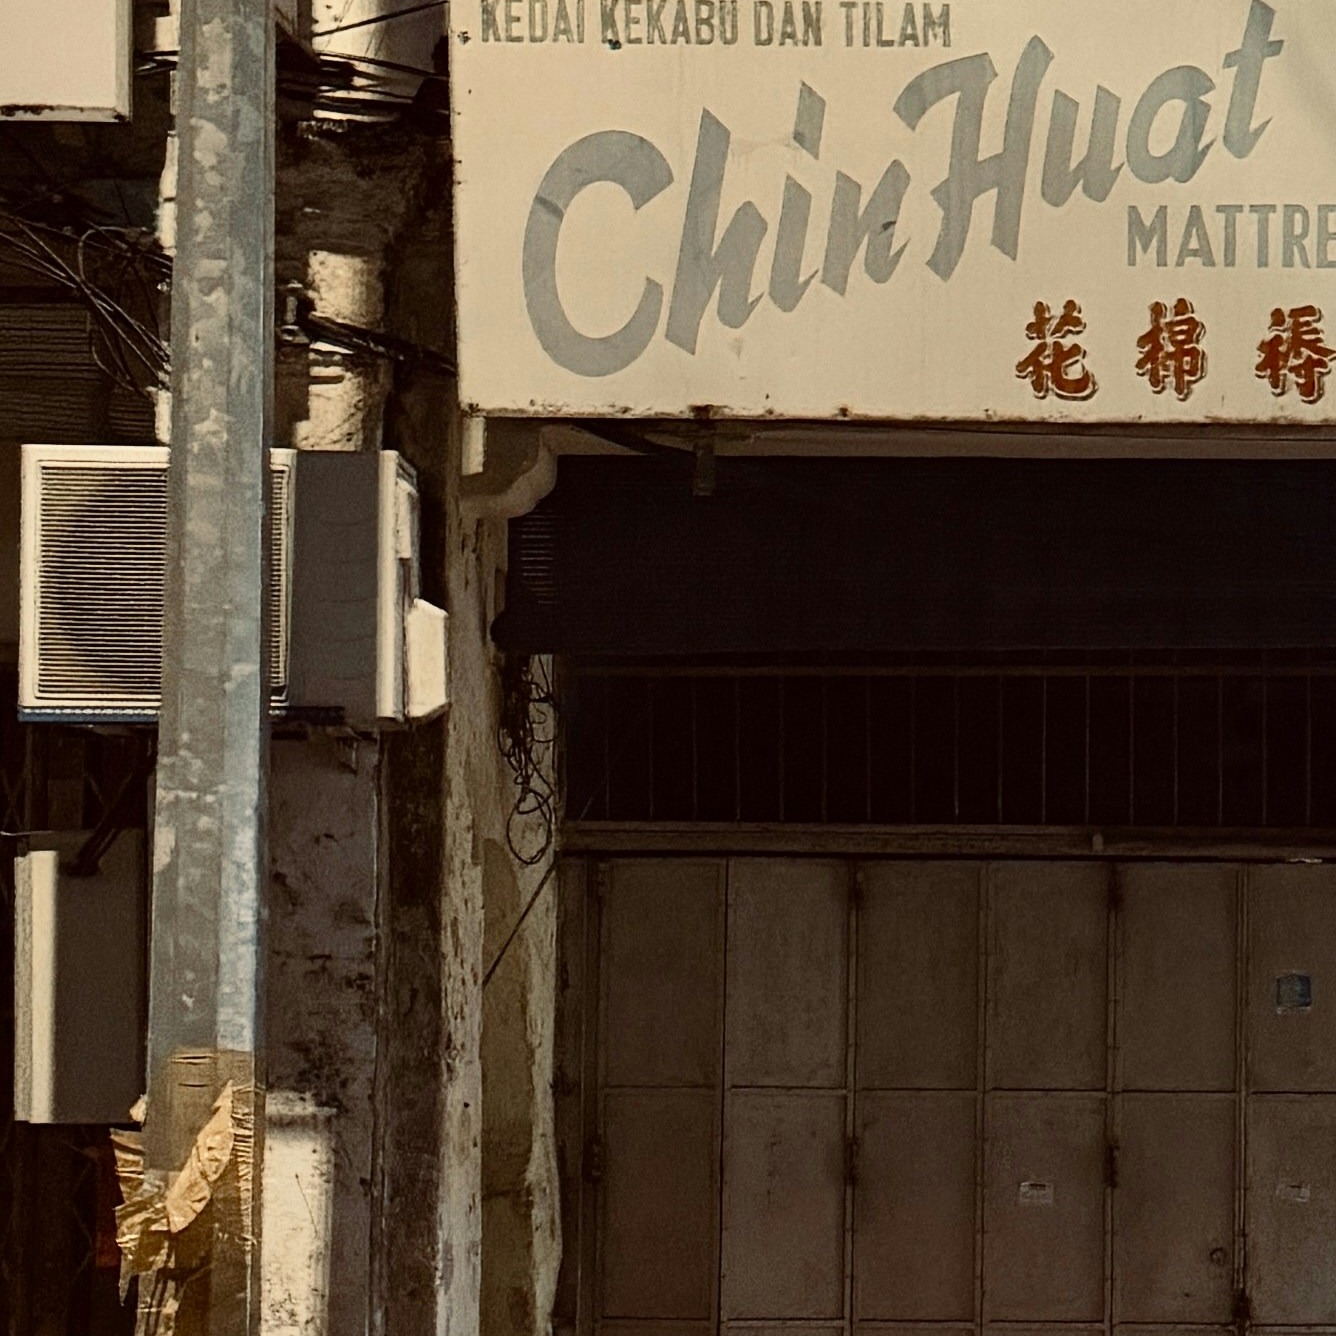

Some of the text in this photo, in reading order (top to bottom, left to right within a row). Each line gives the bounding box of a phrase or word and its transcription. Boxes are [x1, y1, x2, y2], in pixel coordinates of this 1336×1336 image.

[753, 0, 823, 48] DAN
[839, 1, 952, 49] TILAM
[522, 80, 911, 378] Chin
